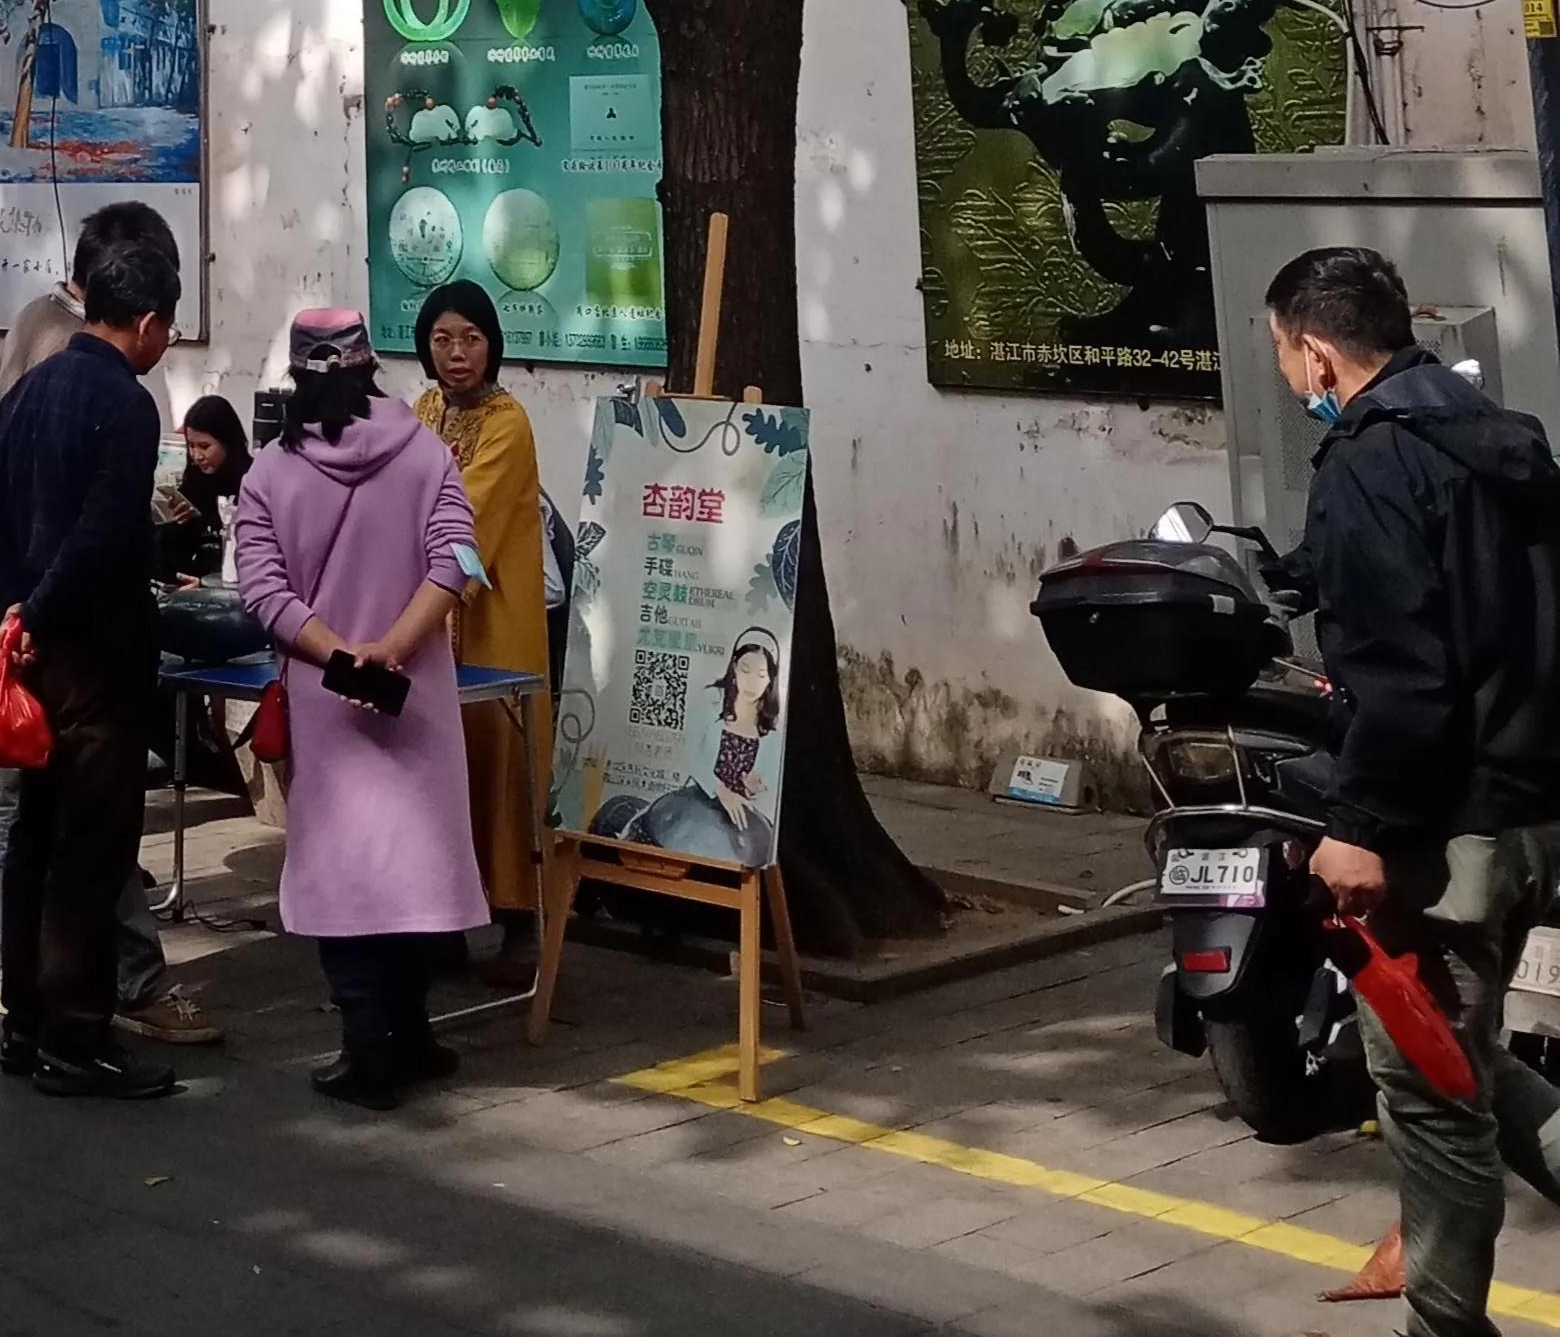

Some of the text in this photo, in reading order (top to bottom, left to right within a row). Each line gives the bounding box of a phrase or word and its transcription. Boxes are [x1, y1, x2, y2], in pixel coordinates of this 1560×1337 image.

[642, 482, 726, 525] 杏韵堂
[639, 603, 669, 625] 吉他
[1190, 865, 1254, 884] JL710
